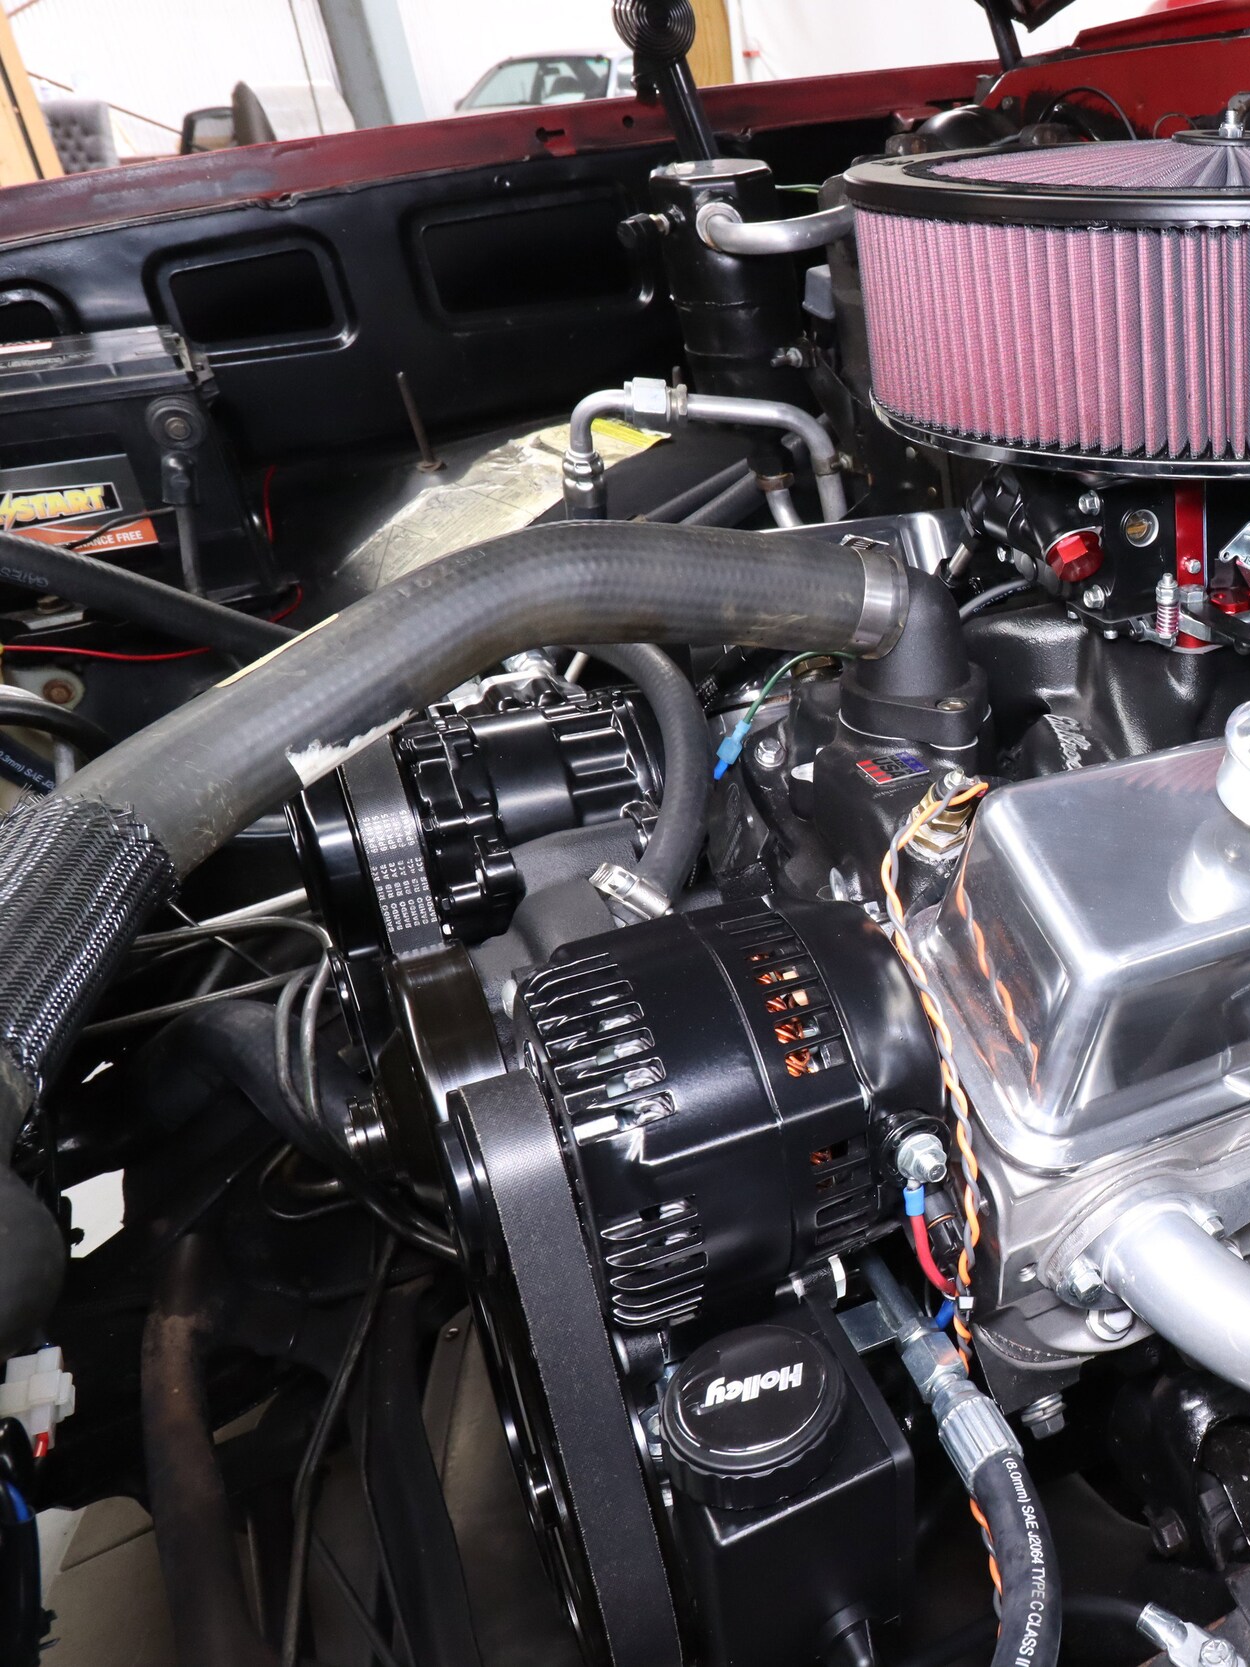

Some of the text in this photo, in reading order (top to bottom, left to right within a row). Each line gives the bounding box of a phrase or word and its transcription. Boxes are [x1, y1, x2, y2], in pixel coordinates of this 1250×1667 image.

[115, 530, 144, 542] FREE
[24, 768, 44, 783] SAE
[871, 757, 907, 779] USA
[380, 863, 390, 880] ACE
[388, 862, 398, 878] ACE
[397, 860, 407, 876] ACE
[385, 883, 395, 899] RIB
[394, 881, 403, 897] RIB
[402, 880, 412, 895] RIB
[411, 877, 421, 893] RIB
[420, 876, 429, 891] RIB
[391, 902, 403, 930] BANDO
[399, 900, 412, 928] BANDO
[407, 899, 420, 926] BANDO
[416, 897, 429, 925] BANDO
[425, 895, 438, 923] BANDO
[705, 1362, 804, 1407] Holley
[1002, 1456, 1032, 1503] (8.0mm)
[1021, 1504, 1039, 1530] SAE
[1027, 1530, 1044, 1564] J2064
[1031, 1566, 1046, 1600] TYPE
[1029, 1600, 1045, 1612] C
[1018, 1612, 1043, 1657] CLASS
